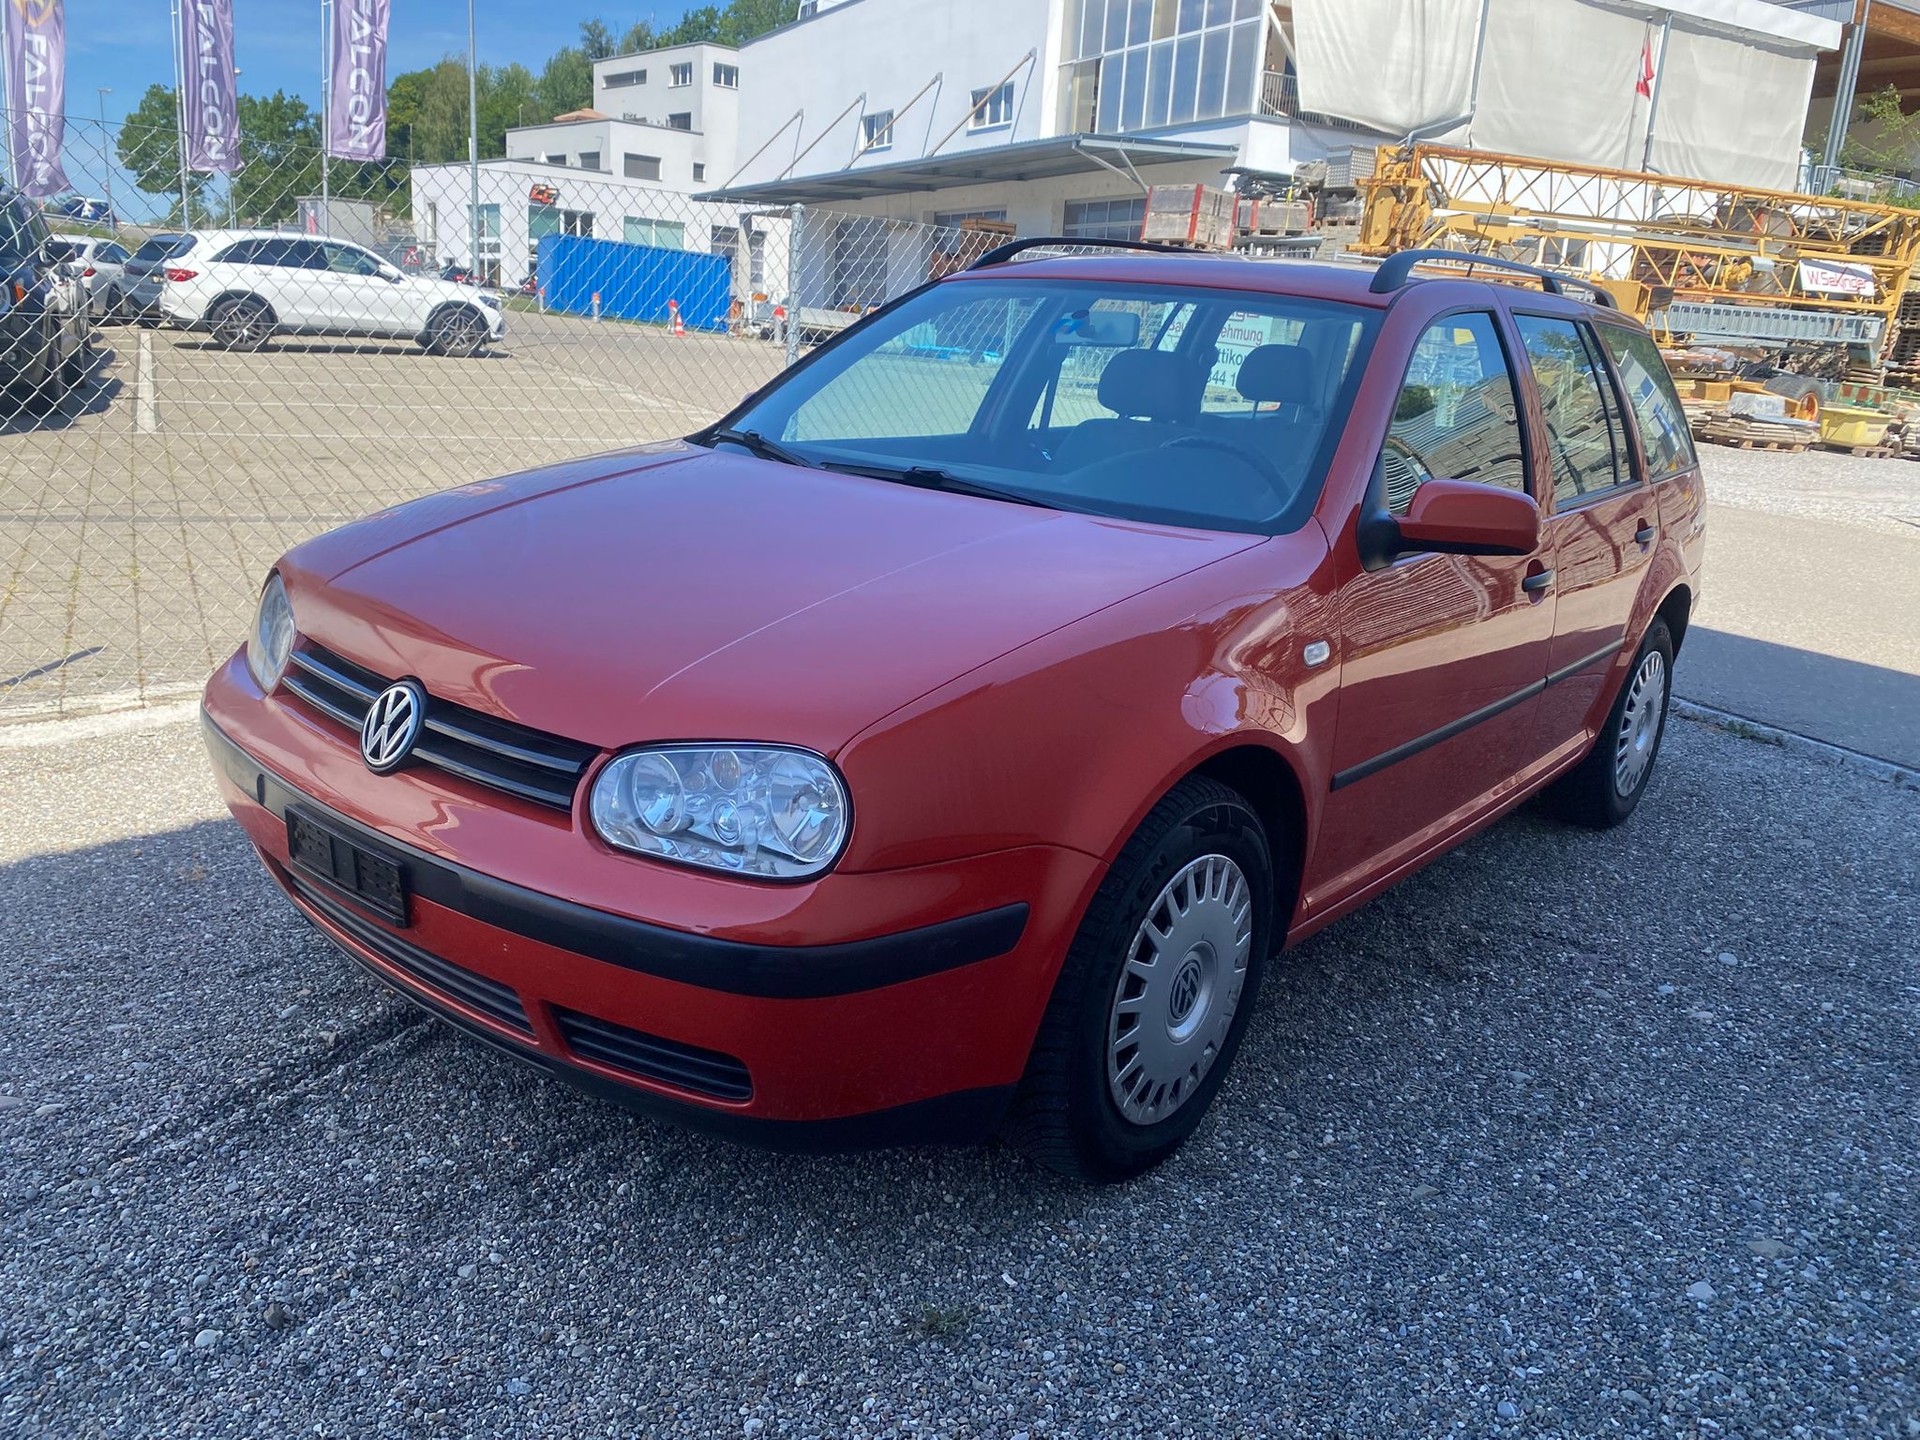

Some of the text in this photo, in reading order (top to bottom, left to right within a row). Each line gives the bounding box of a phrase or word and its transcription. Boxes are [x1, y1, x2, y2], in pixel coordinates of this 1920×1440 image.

[24, 32, 50, 187] FALCON
[196, 3, 227, 161] FALCON
[362, 685, 420, 766] VW
